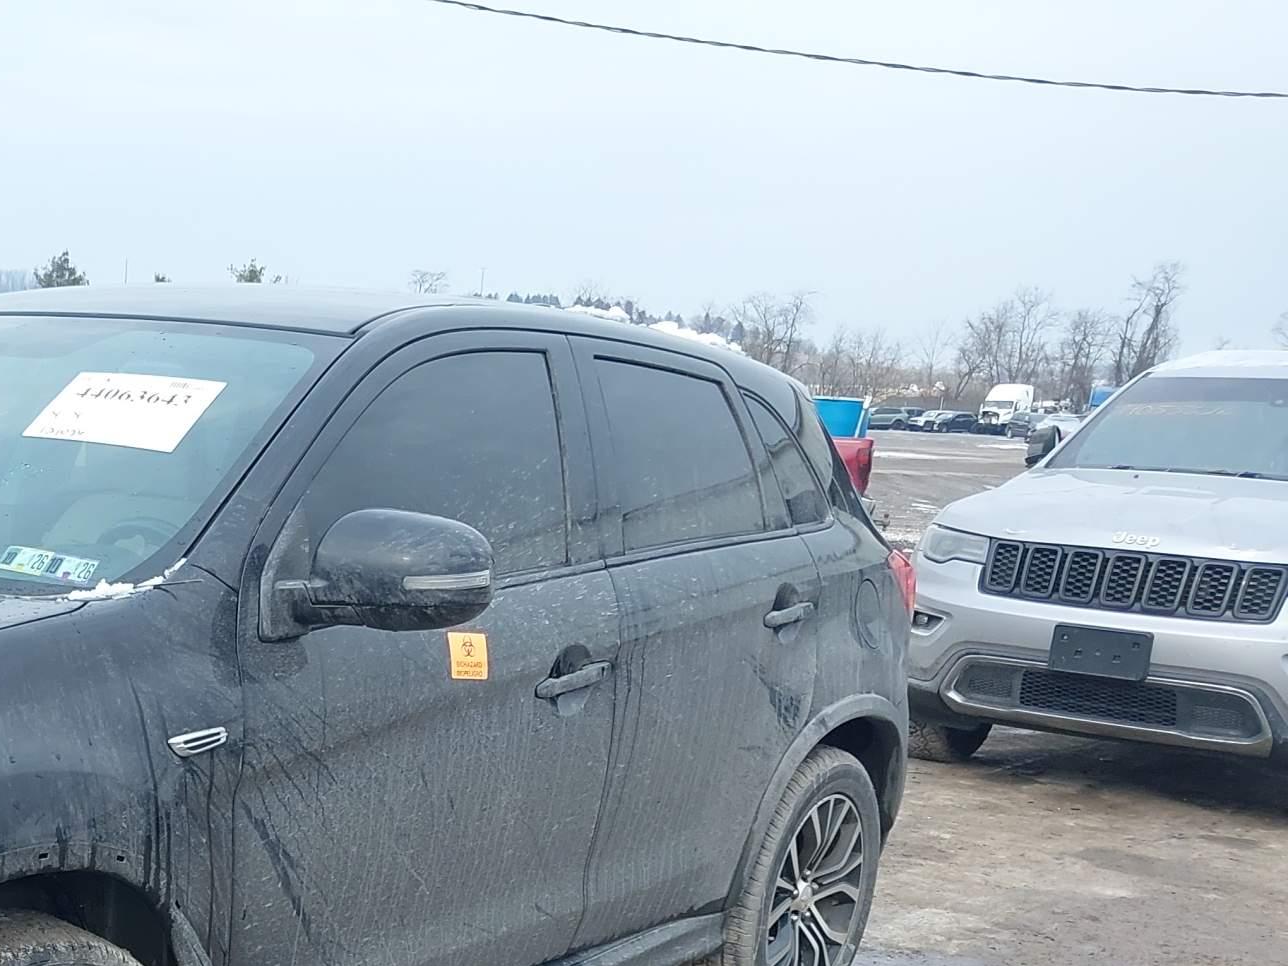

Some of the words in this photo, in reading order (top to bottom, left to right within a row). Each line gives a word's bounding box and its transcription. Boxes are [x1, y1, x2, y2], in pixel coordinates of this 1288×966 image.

[1112, 531, 1160, 550] Jeep
[31, 553, 49, 571] 26
[77, 562, 95, 580] 26
